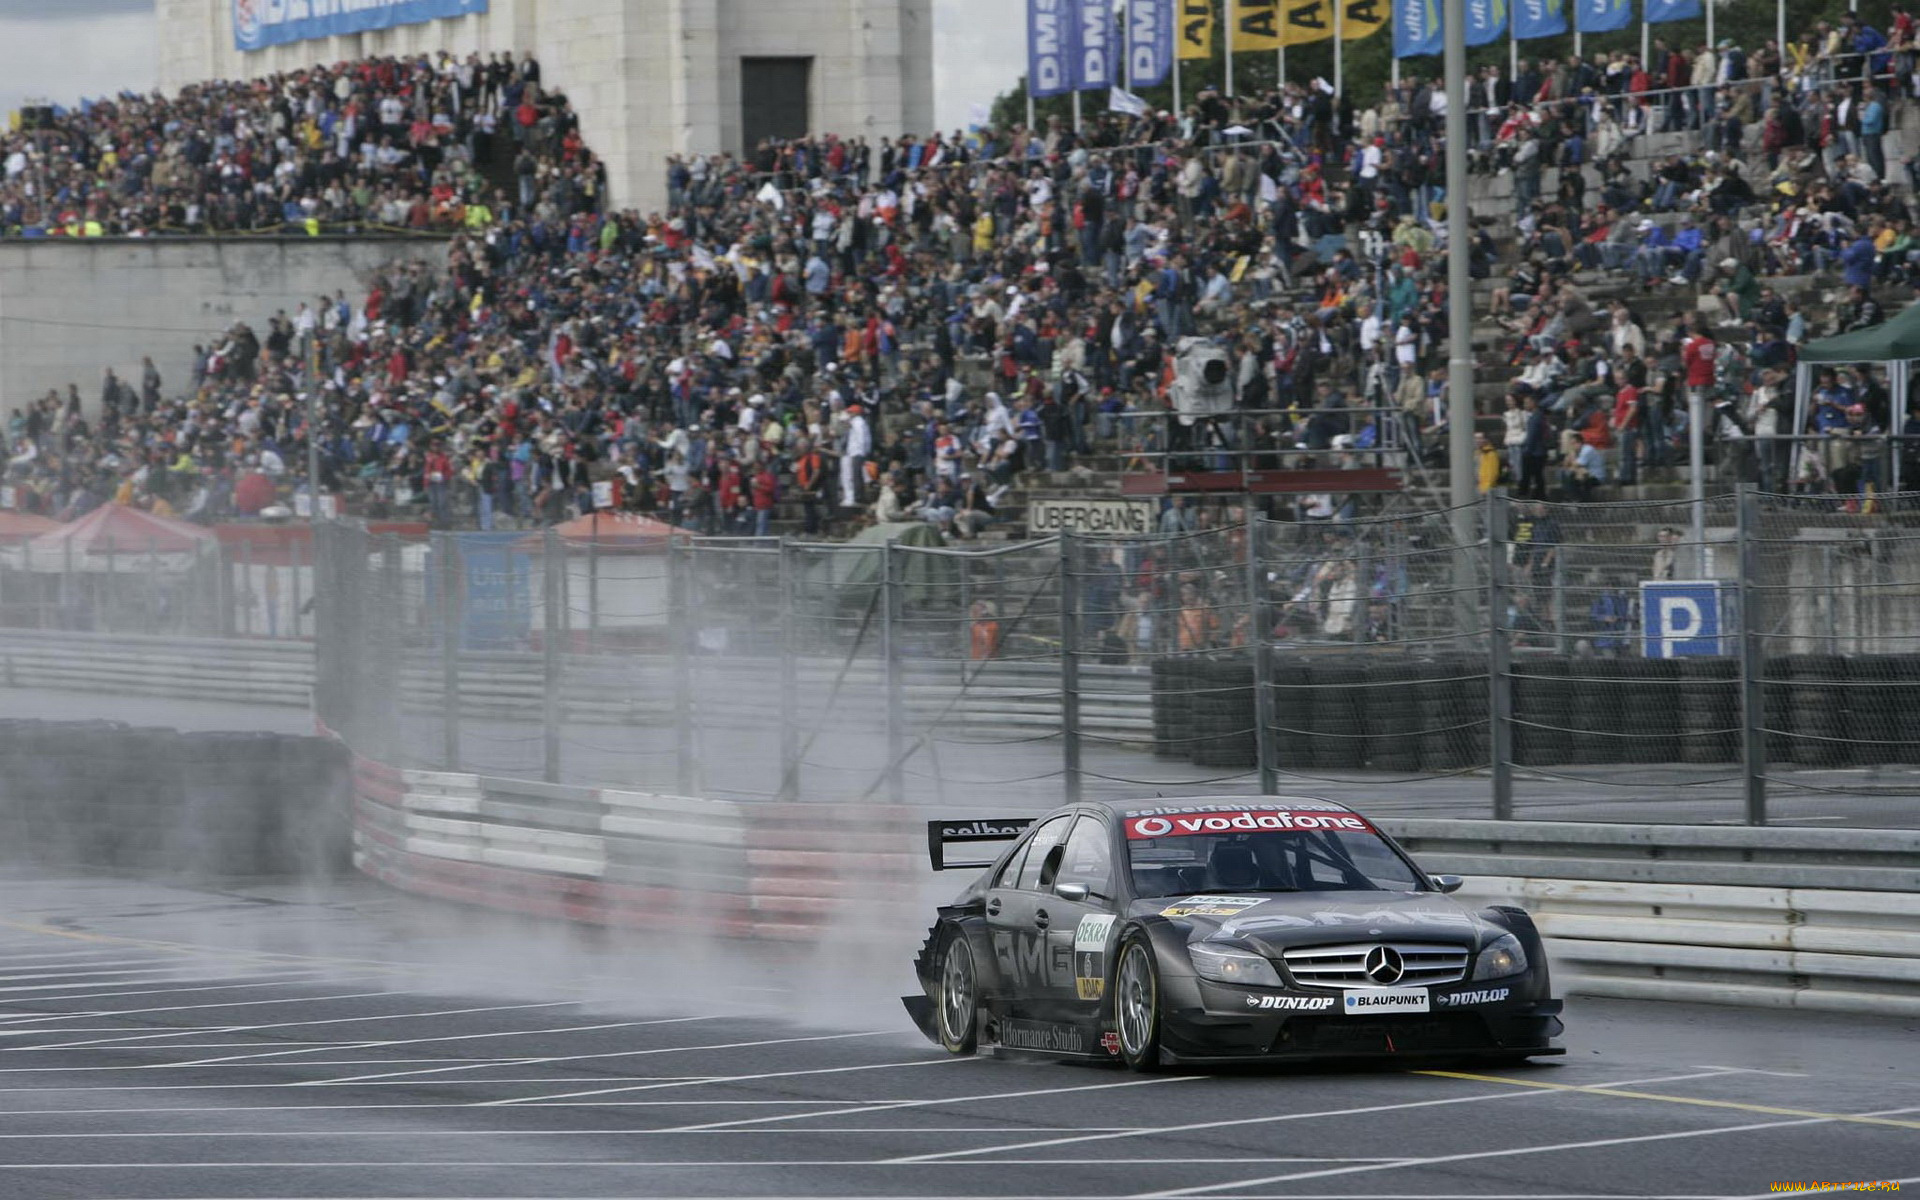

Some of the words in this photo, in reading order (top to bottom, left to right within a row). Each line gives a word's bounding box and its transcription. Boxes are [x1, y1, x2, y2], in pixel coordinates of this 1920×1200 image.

[1034, 502, 1145, 532] ÜBERGANG
[1660, 597, 1702, 659] P
[1177, 812, 1367, 832] vodafone
[1077, 922, 1108, 942] DEKRA
[1084, 952, 1092, 978] 6
[1082, 979, 1101, 999] ADAC
[1449, 988, 1510, 1006] DUNLOP
[1259, 996, 1335, 1010] DUNLOP
[1357, 995, 1427, 1007] BLAUPUNKT
[1052, 1025, 1083, 1052] Studio
